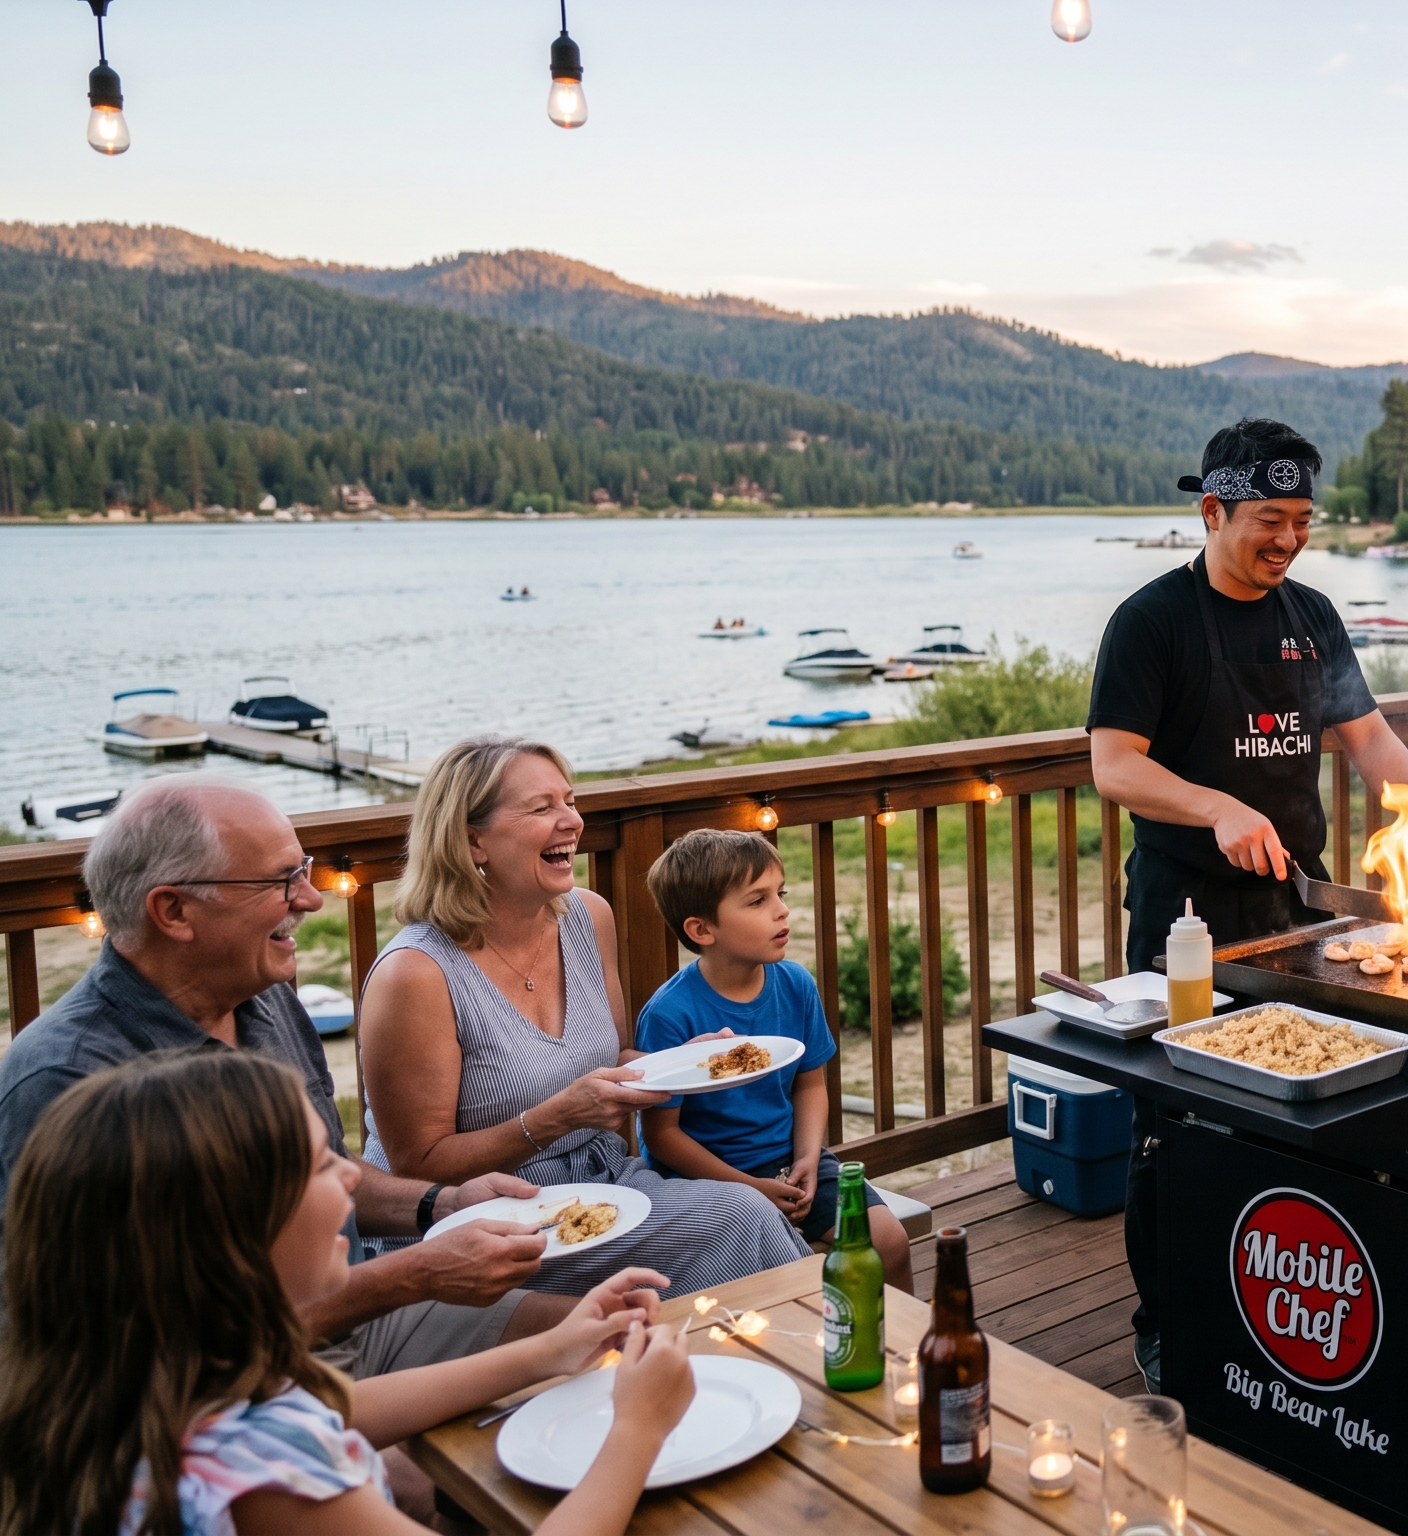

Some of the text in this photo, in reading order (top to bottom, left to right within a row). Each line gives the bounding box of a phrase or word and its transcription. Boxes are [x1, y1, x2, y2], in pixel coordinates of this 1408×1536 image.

[1234, 734, 1312, 758] HIBACHI
[1243, 1230, 1364, 1297] Mobile
[1266, 1287, 1351, 1361] Chef
[1223, 1362, 1390, 1455] Big Bear Lake
